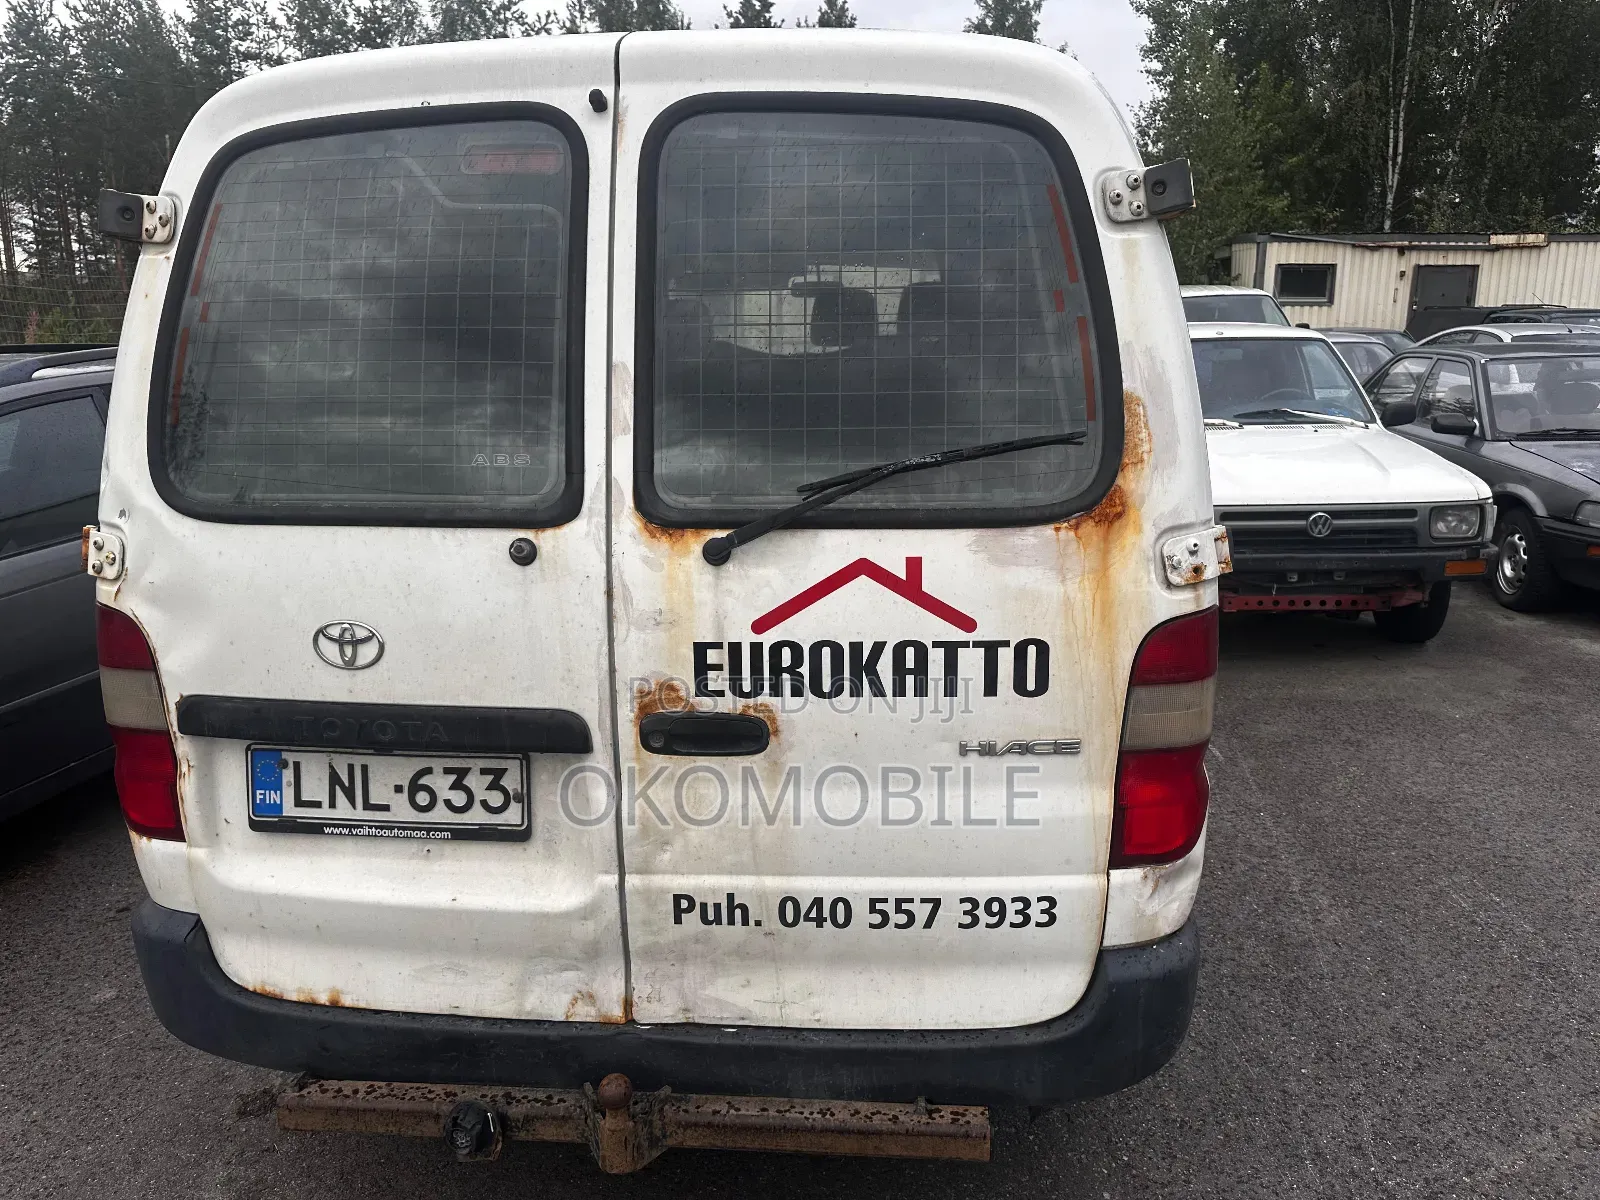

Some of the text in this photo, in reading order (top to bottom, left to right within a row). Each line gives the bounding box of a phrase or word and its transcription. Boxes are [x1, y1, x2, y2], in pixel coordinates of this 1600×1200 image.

[471, 453, 531, 466] ABS
[693, 637, 1050, 700] EUROKATTO
[293, 716, 450, 743] TOYOTA
[959, 738, 1082, 757] HIACE
[256, 790, 281, 804] FIN
[292, 760, 513, 814] LNL-633
[323, 826, 451, 840] www.vaihtoautomaa.com
[672, 893, 1058, 930] Puh. 040 557 3933
